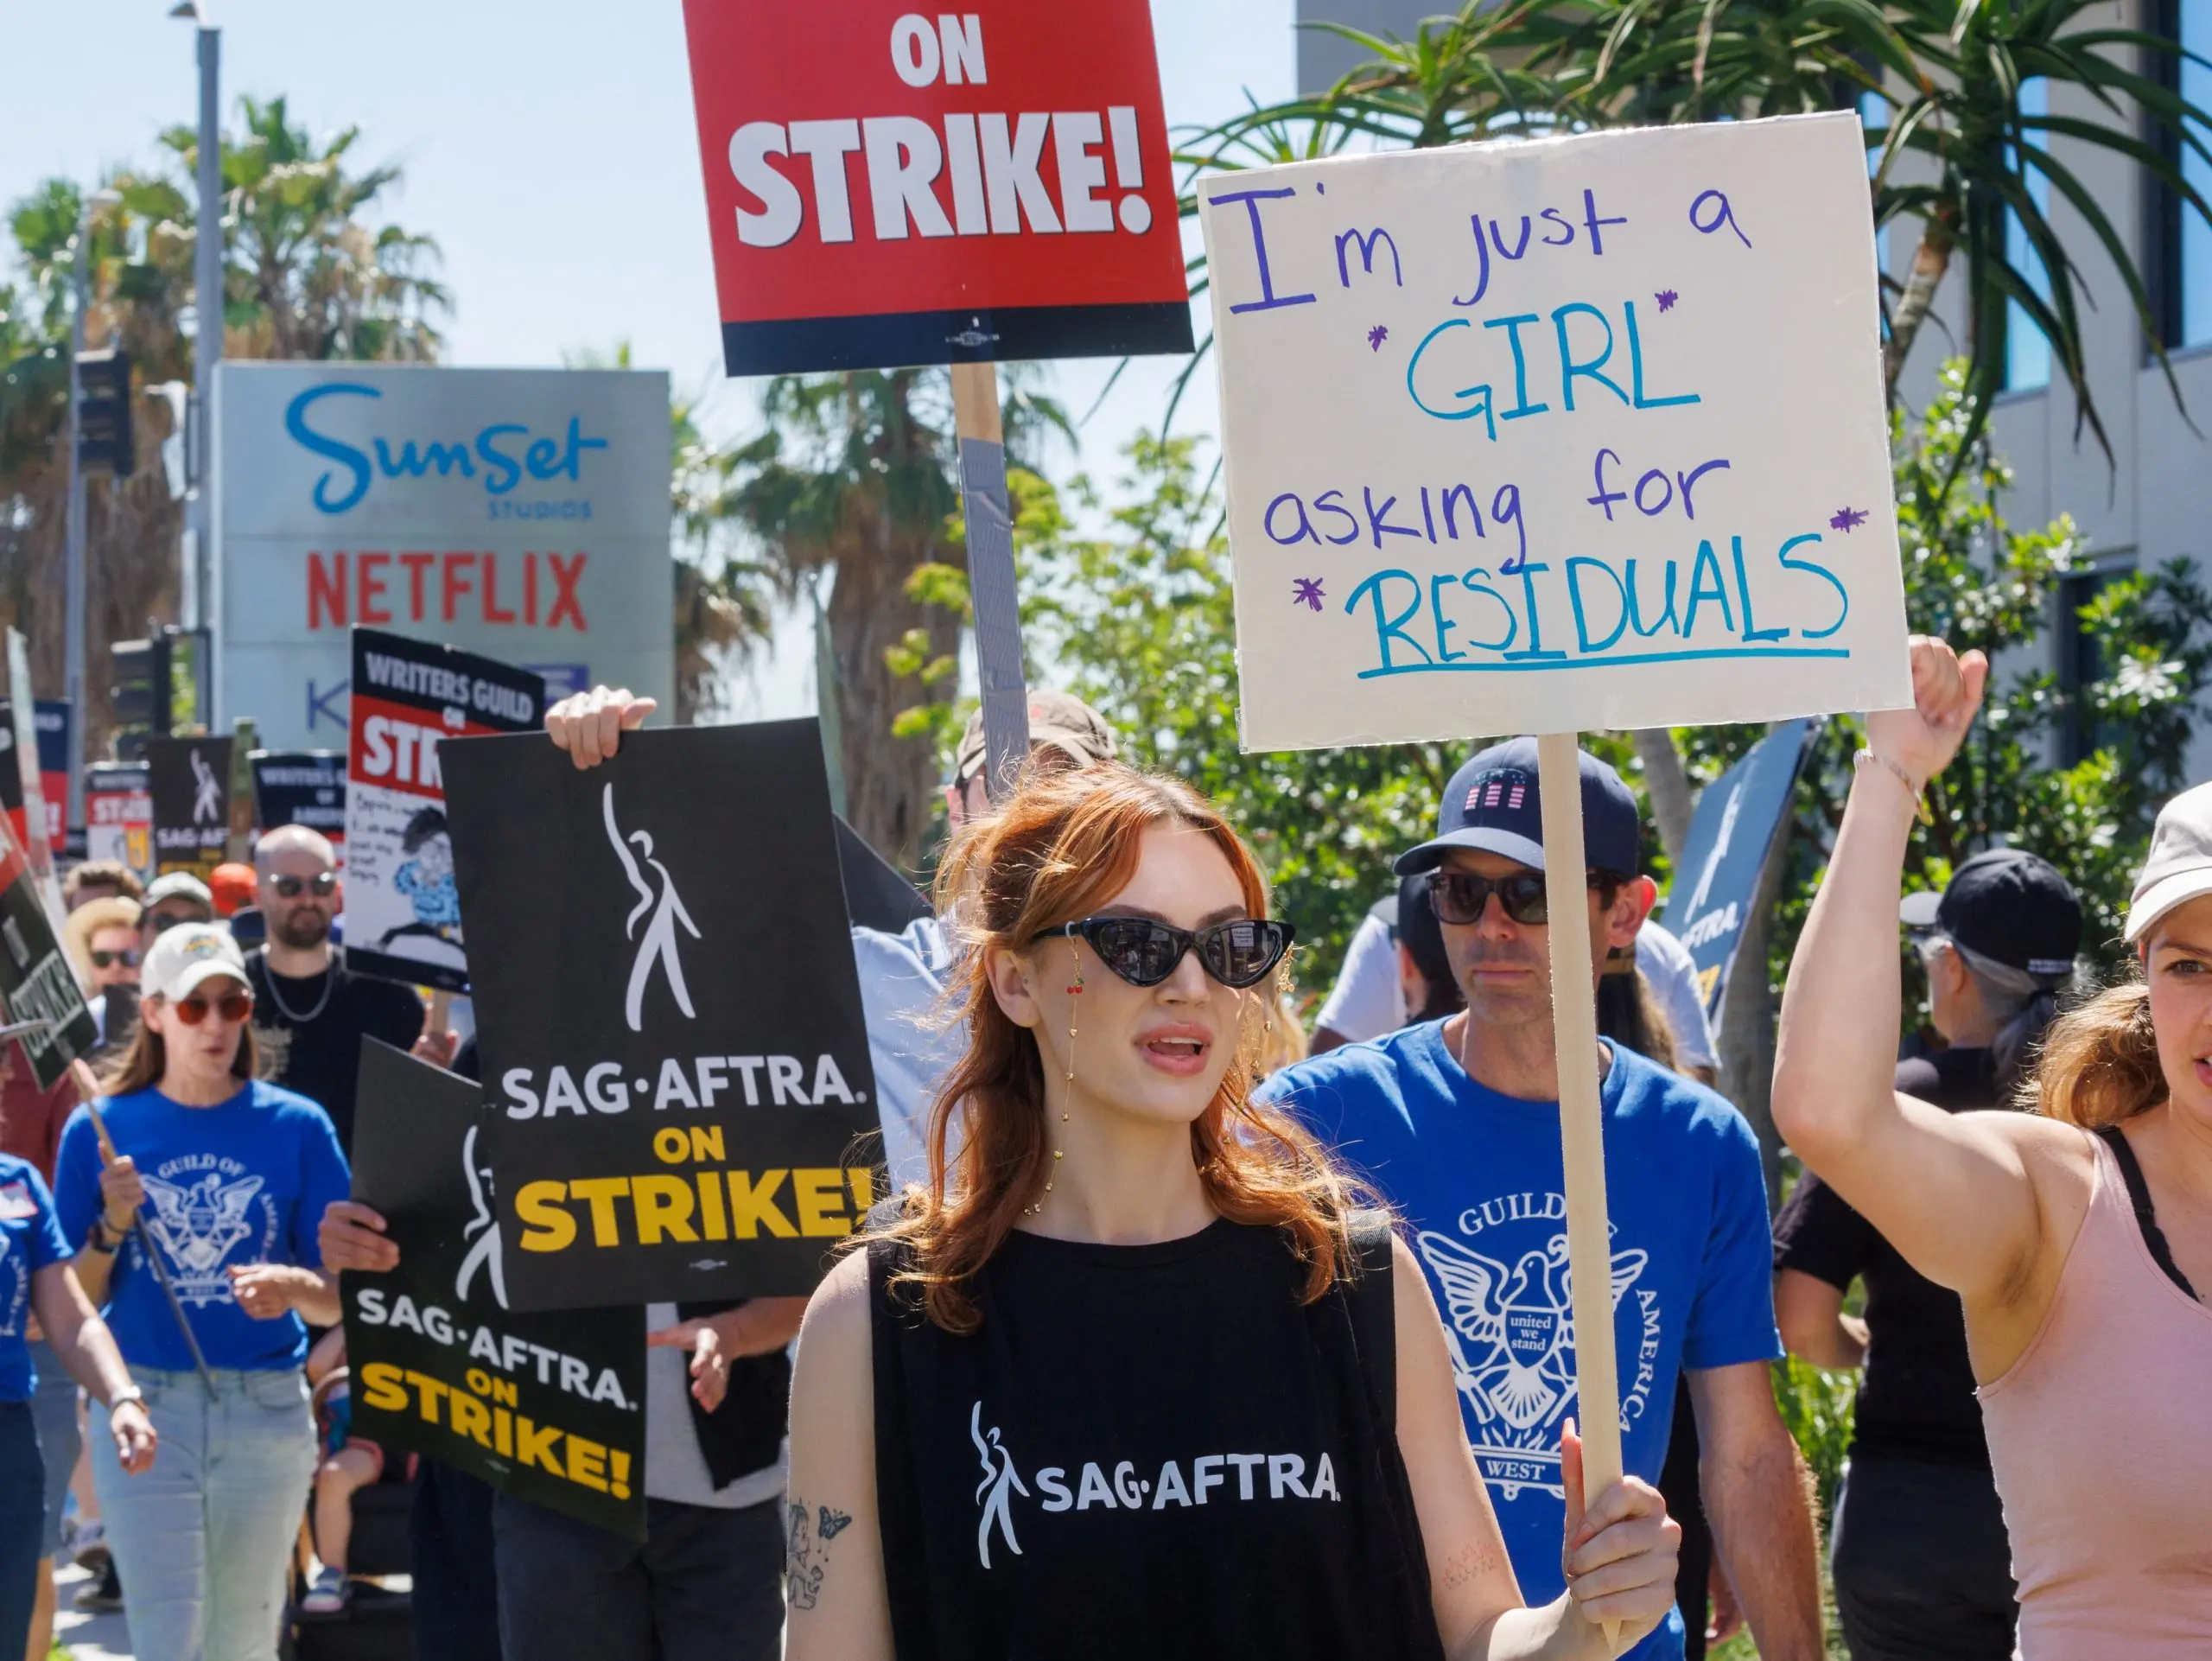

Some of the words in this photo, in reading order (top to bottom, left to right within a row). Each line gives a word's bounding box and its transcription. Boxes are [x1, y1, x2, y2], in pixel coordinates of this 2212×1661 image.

[891, 13, 988, 88] ON
[728, 105, 1153, 249] STRIKE!
[1209, 181, 1403, 315] I'm
[1452, 188, 1628, 308] just
[1688, 188, 1752, 249] a
[1406, 300, 1702, 442] GIRL
[487, 500, 594, 519] STUDIOS
[1263, 482, 1524, 576] asking
[1586, 448, 1731, 520] for
[306, 550, 588, 633] NETFLIX
[1344, 532, 1850, 672] RESIDUALS
[364, 651, 470, 705] WRITERS
[473, 678, 534, 724] GUILD
[442, 705, 467, 730] ON
[158, 1153, 216, 1179] GUILD
[219, 1156, 246, 1177] OF
[652, 1125, 726, 1164] ON
[514, 1167, 874, 1253] STRIKE!
[1459, 1192, 1567, 1236] GUILD
[1510, 1314, 1552, 1330] united
[1510, 1338, 1547, 1352] stand
[1520, 1329, 1540, 1340] we
[465, 1367, 518, 1409] ON
[1620, 1288, 1660, 1434] AMERICA
[360, 1361, 632, 1501] STRIKE!
[1484, 1459, 1546, 1481] WEST
